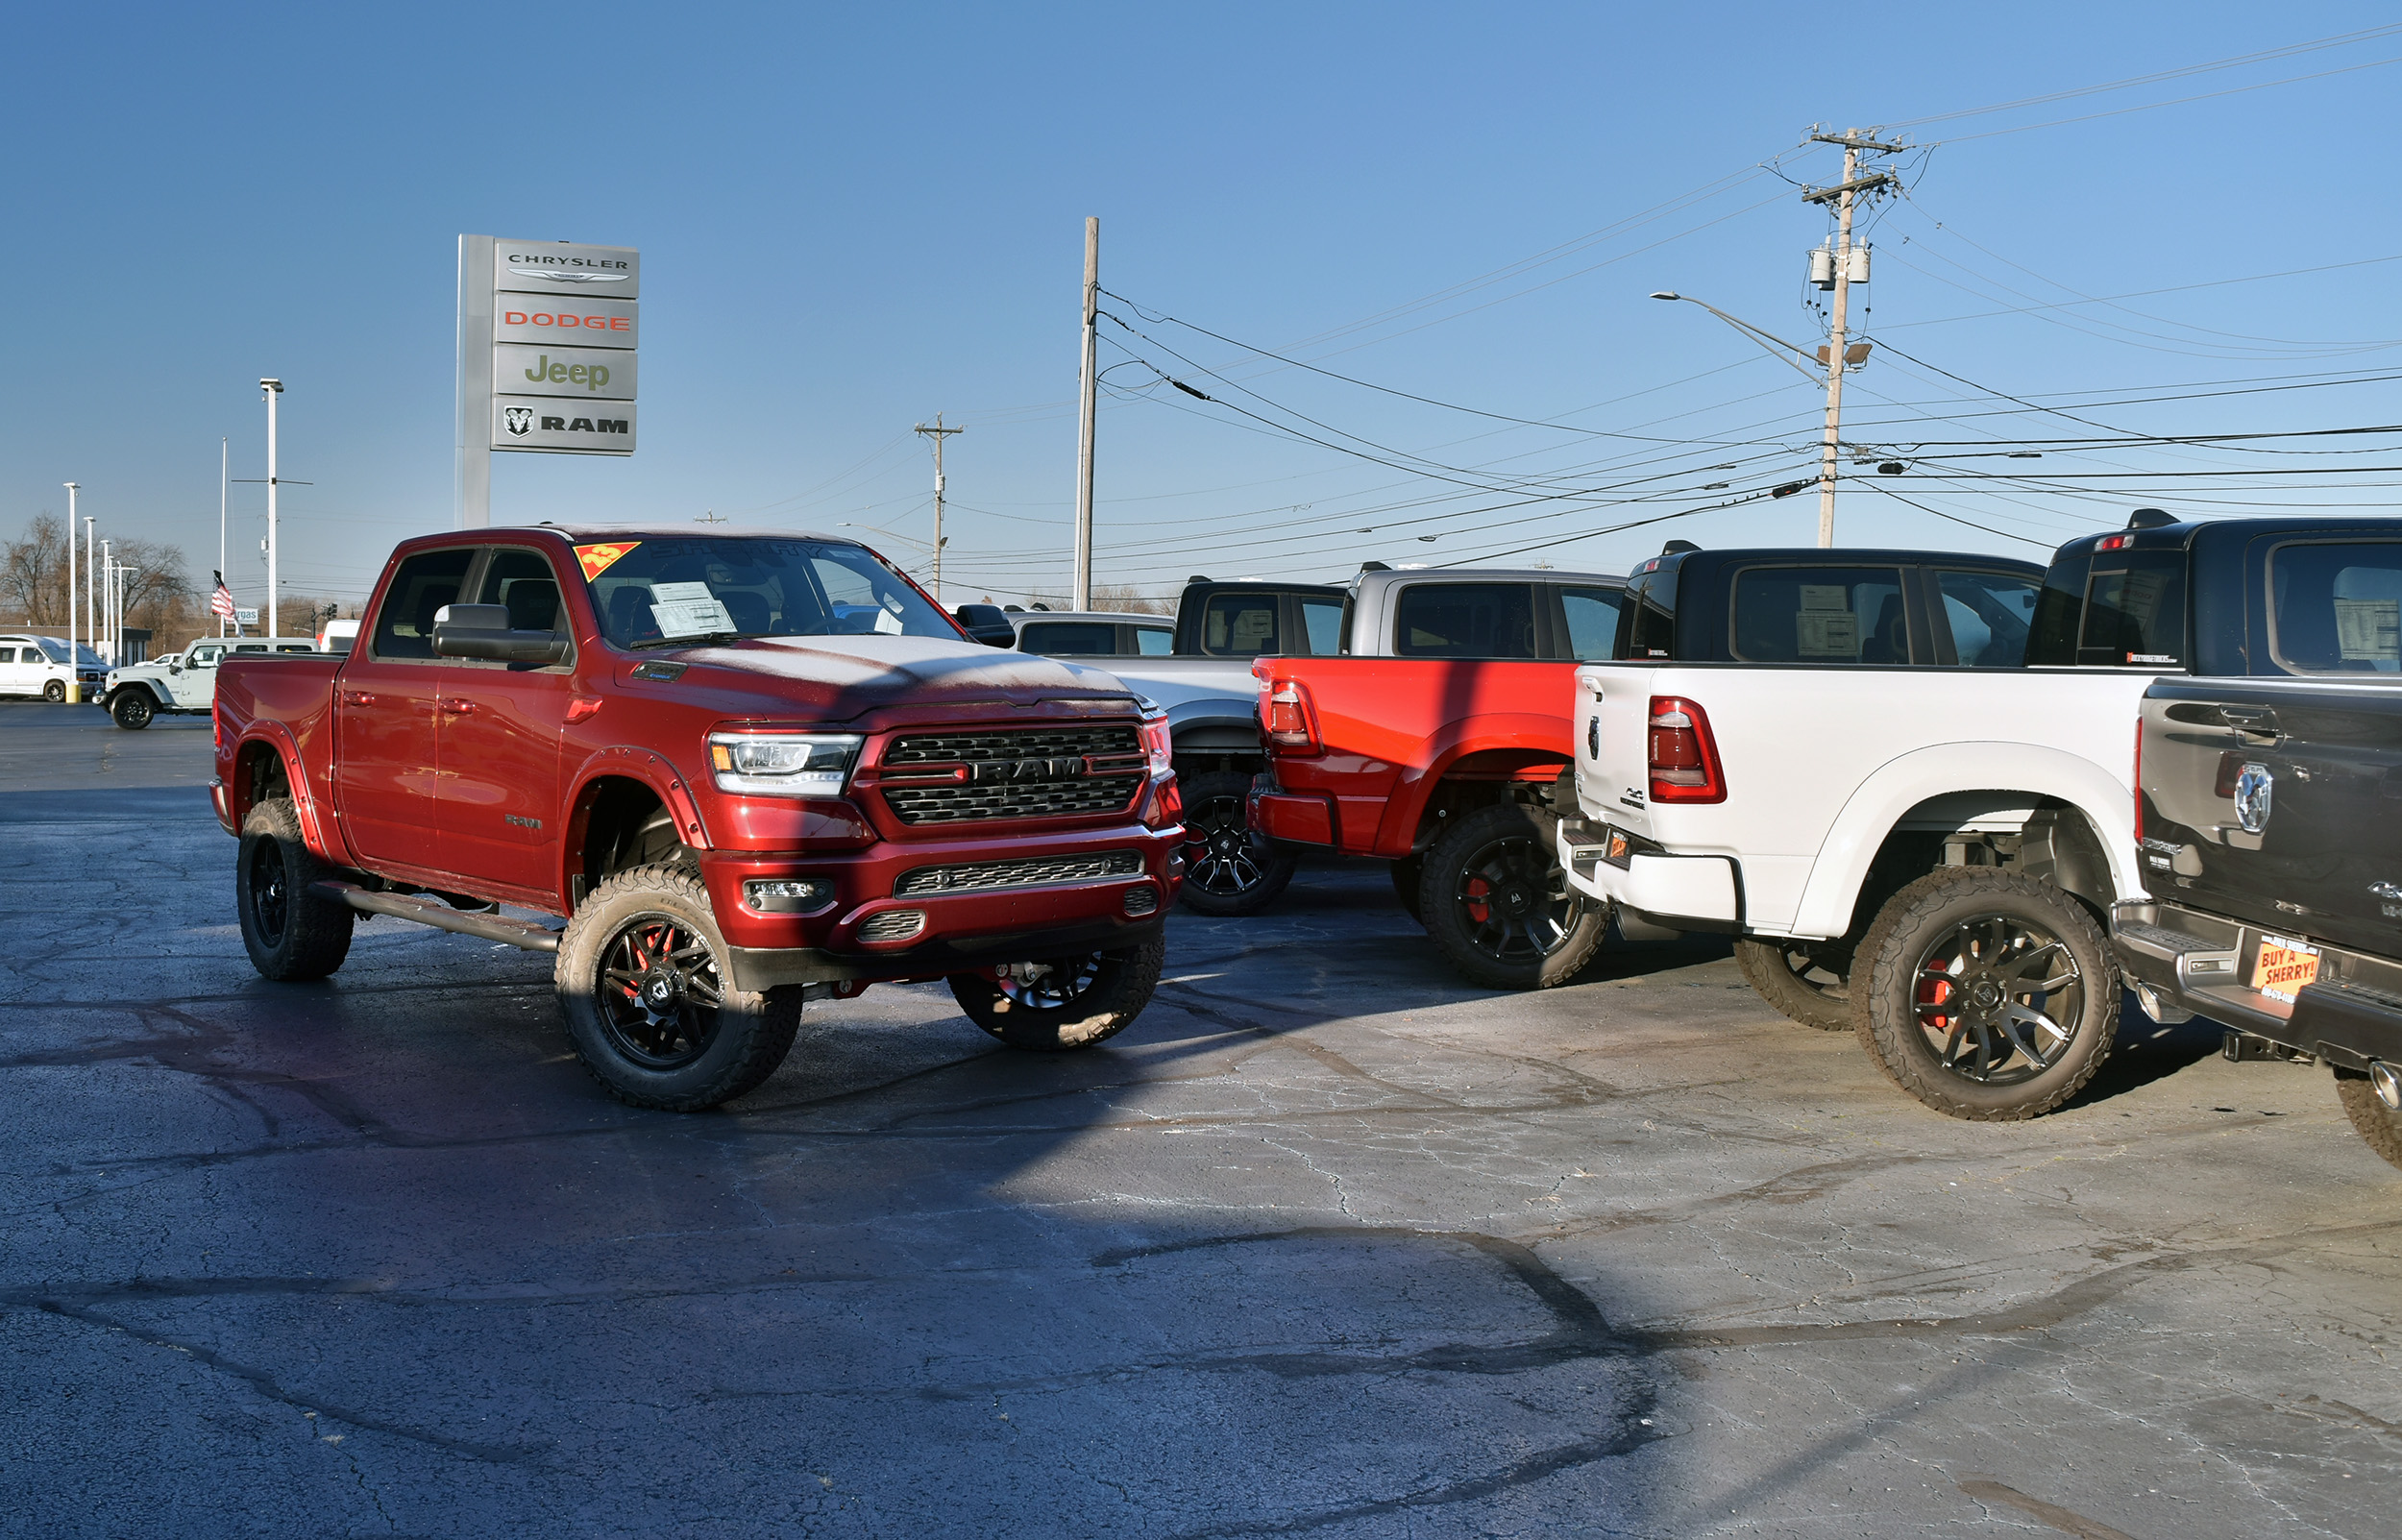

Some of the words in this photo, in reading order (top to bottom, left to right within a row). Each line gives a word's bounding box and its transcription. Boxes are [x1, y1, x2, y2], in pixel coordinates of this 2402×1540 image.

[508, 255, 628, 270] CHRYSLER
[504, 311, 630, 330] DODGE
[525, 354, 610, 391] Jeep
[540, 416, 629, 434] RAM
[581, 545, 622, 568] 23
[649, 539, 823, 560] SHERRY
[972, 759, 1083, 780] RAM
[504, 813, 543, 830] RAM
[2262, 949, 2287, 968] BUY
[2288, 950, 2296, 964] A
[2266, 961, 2315, 985] SHERRY!
